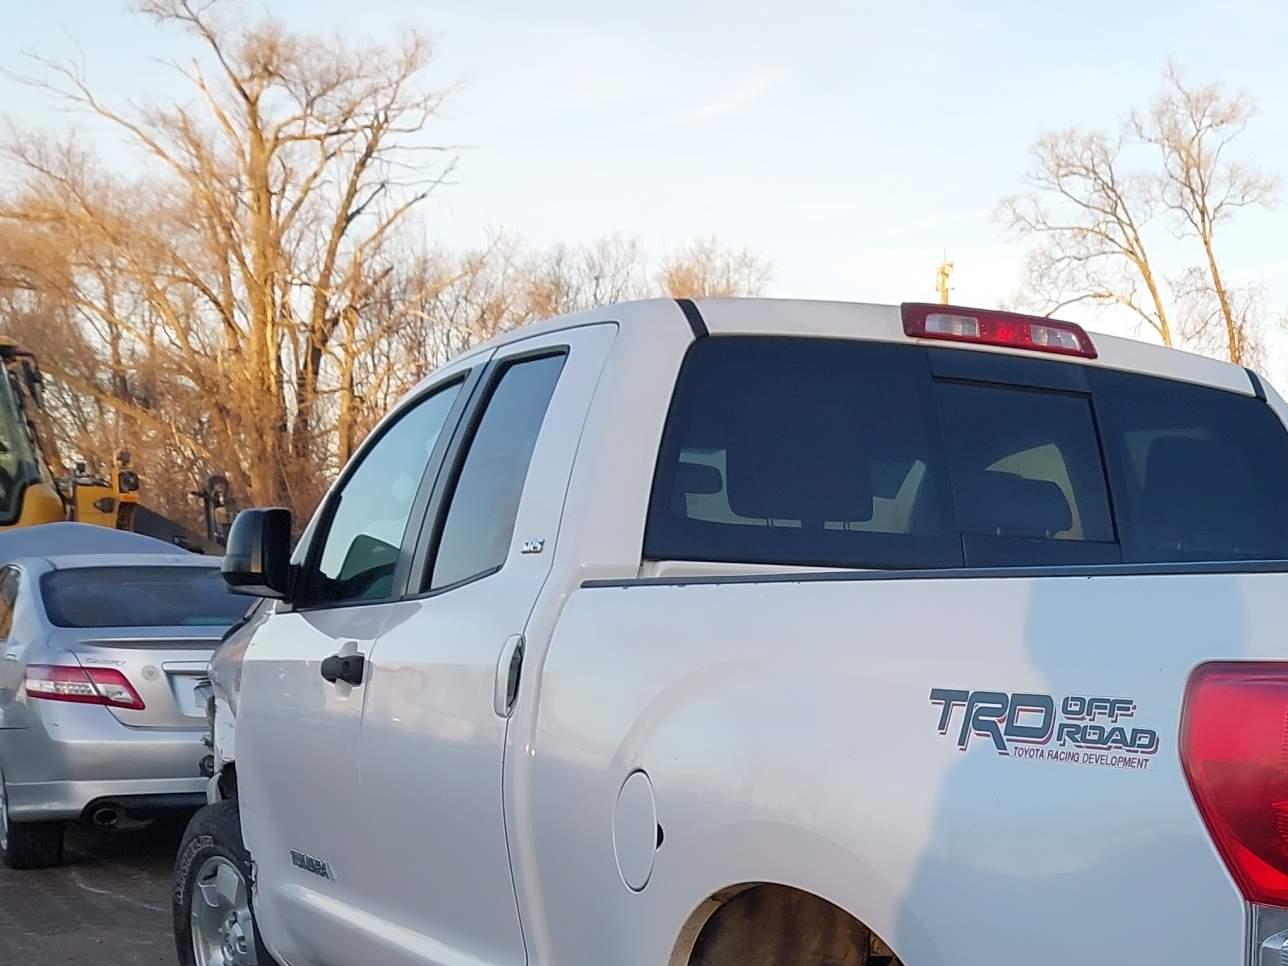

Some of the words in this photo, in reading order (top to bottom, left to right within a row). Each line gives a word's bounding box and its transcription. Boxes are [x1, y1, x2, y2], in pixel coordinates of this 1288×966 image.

[929, 688, 1056, 756] TRD
[1061, 696, 1137, 723] OFF
[1055, 723, 1160, 755] ROAD
[1013, 746, 1045, 760] TOYOTA
[1047, 750, 1080, 763] RACING
[1081, 754, 1150, 770] DEVELOPMENT
